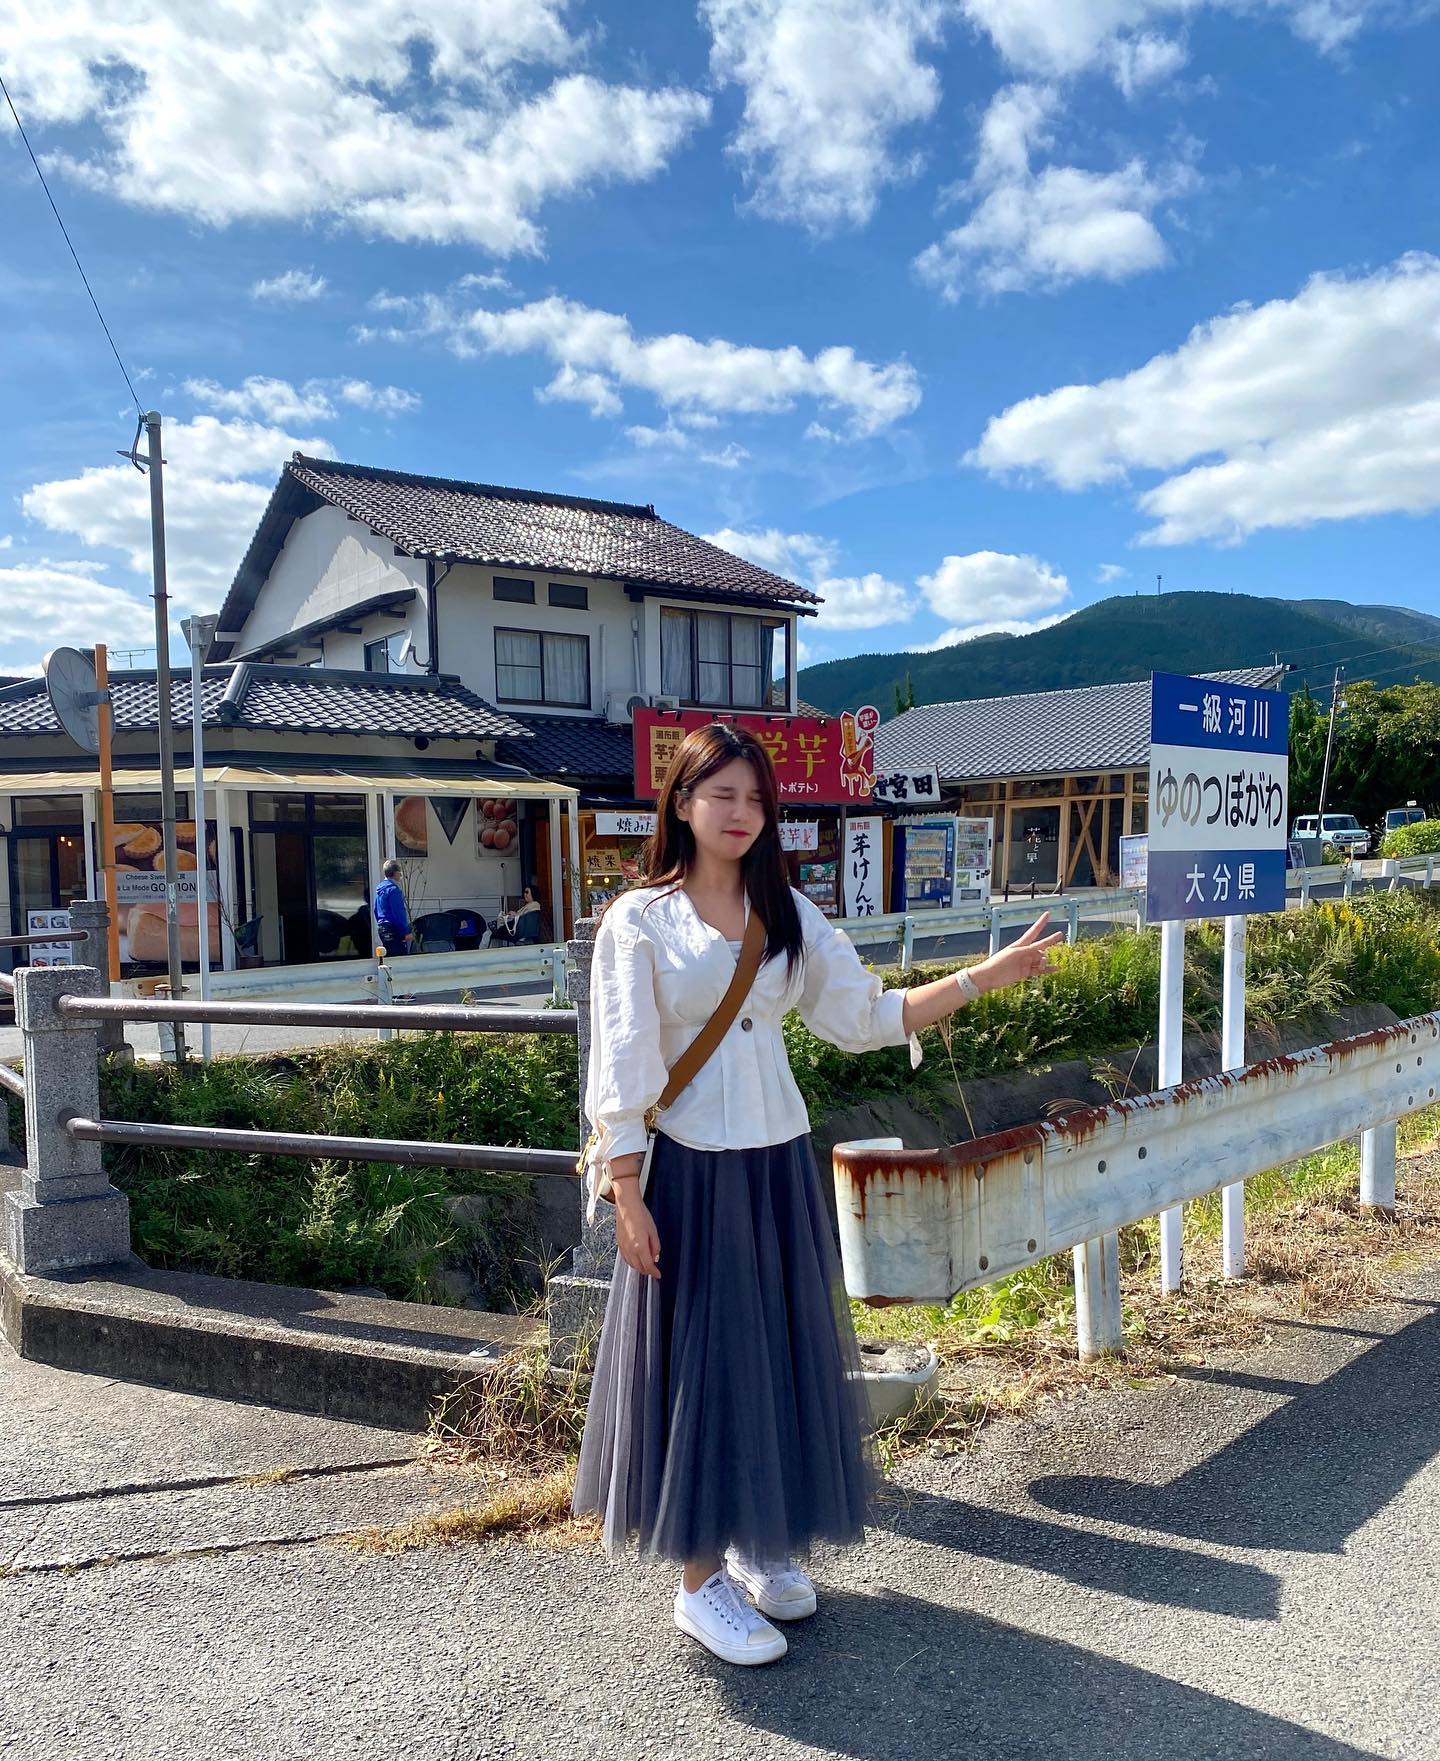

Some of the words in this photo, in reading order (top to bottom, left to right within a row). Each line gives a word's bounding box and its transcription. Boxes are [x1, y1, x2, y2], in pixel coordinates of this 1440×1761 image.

[1178, 692, 1269, 739] 一級河川
[1155, 767, 1283, 829] ゆのつぼがわ
[1185, 863, 1256, 904] 大分県
